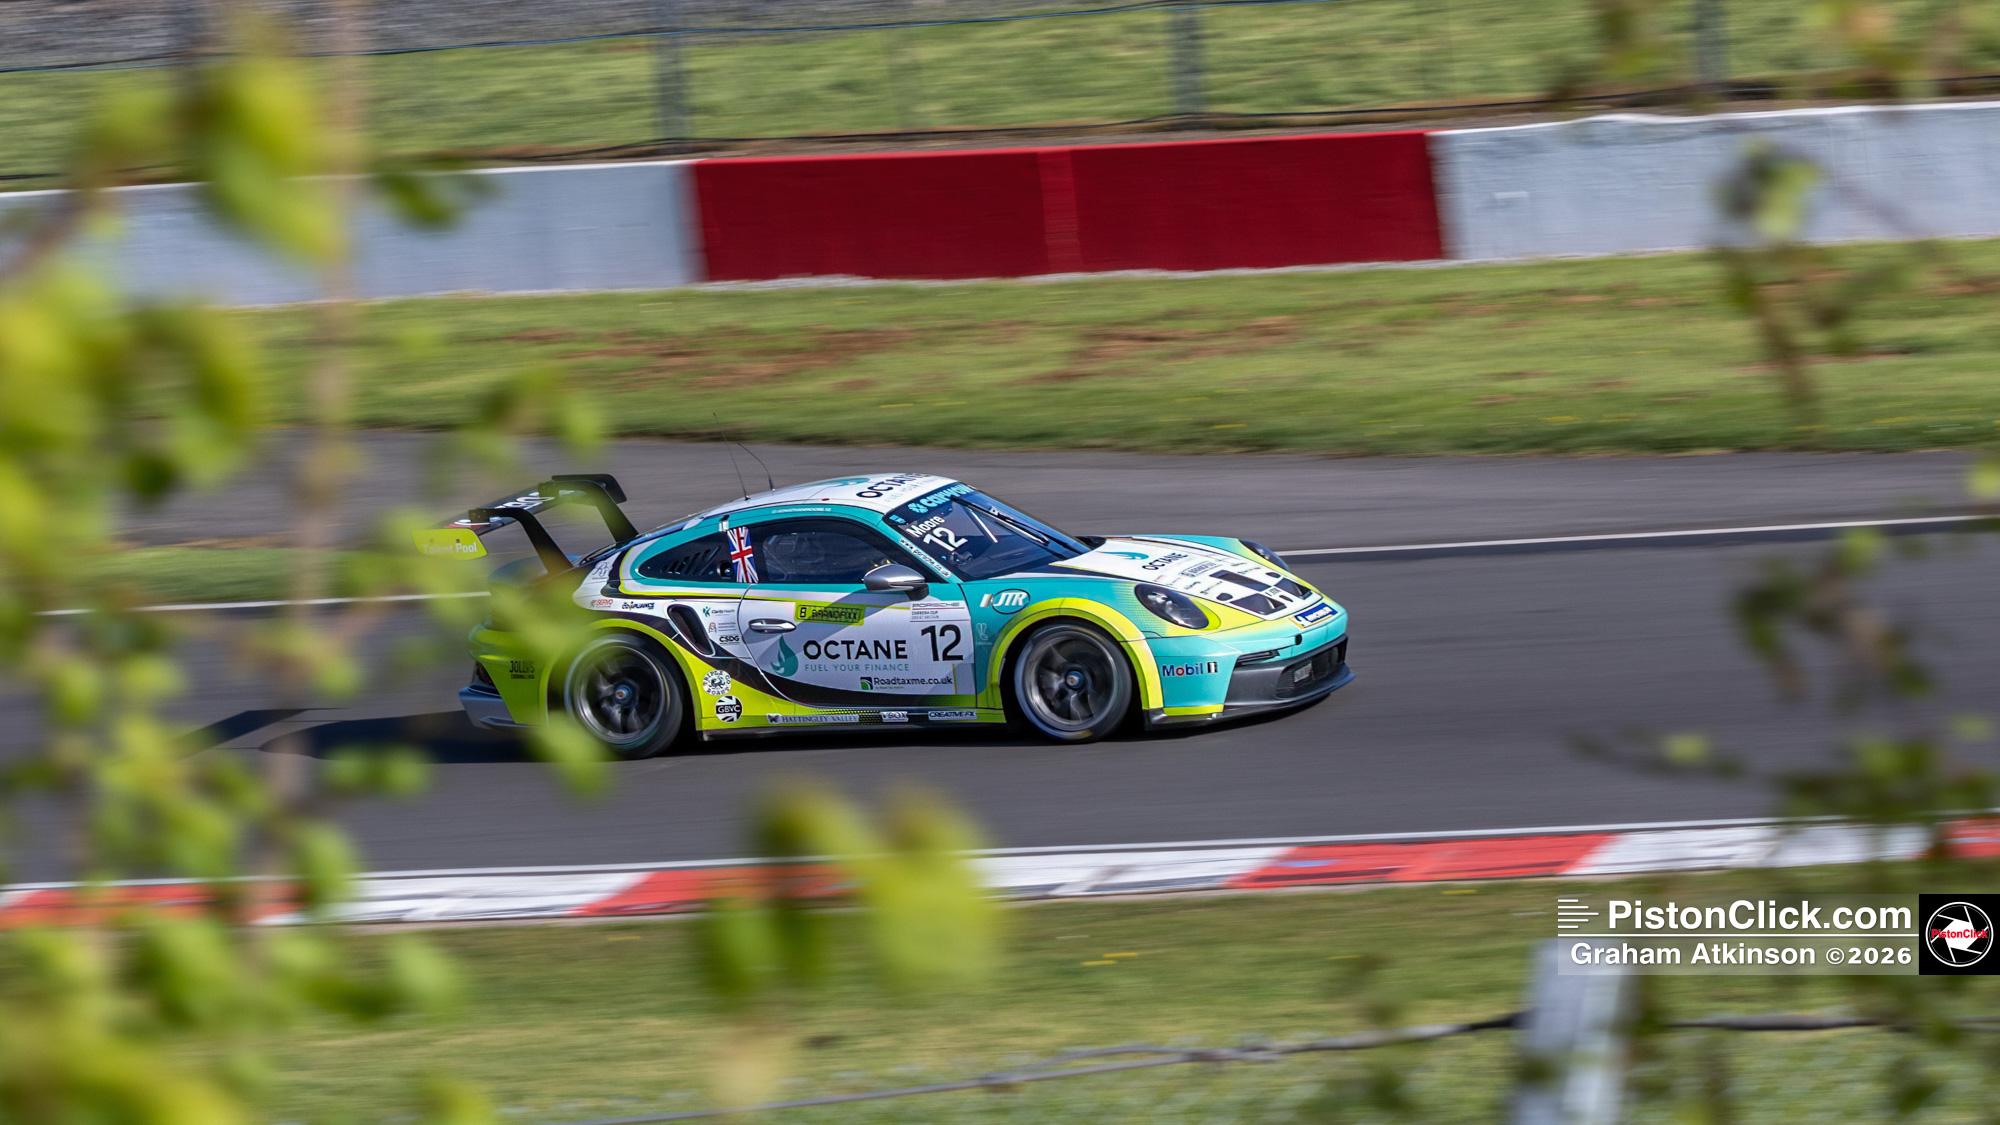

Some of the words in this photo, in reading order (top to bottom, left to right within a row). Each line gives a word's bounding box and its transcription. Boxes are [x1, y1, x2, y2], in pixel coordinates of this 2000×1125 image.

[906, 516, 945, 537] Moore
[923, 527, 968, 551] 12
[455, 542, 477, 553] Pool
[992, 592, 1027, 607] JTR
[803, 640, 907, 660] OCTANE
[921, 624, 964, 662] 12
[804, 664, 829, 672] FUEL
[865, 663, 910, 672] FINANCE
[1162, 662, 1204, 677] Mobil
[874, 676, 953, 685] Roadtaxme.co.uk
[782, 715, 828, 723] HATTINGLEY
